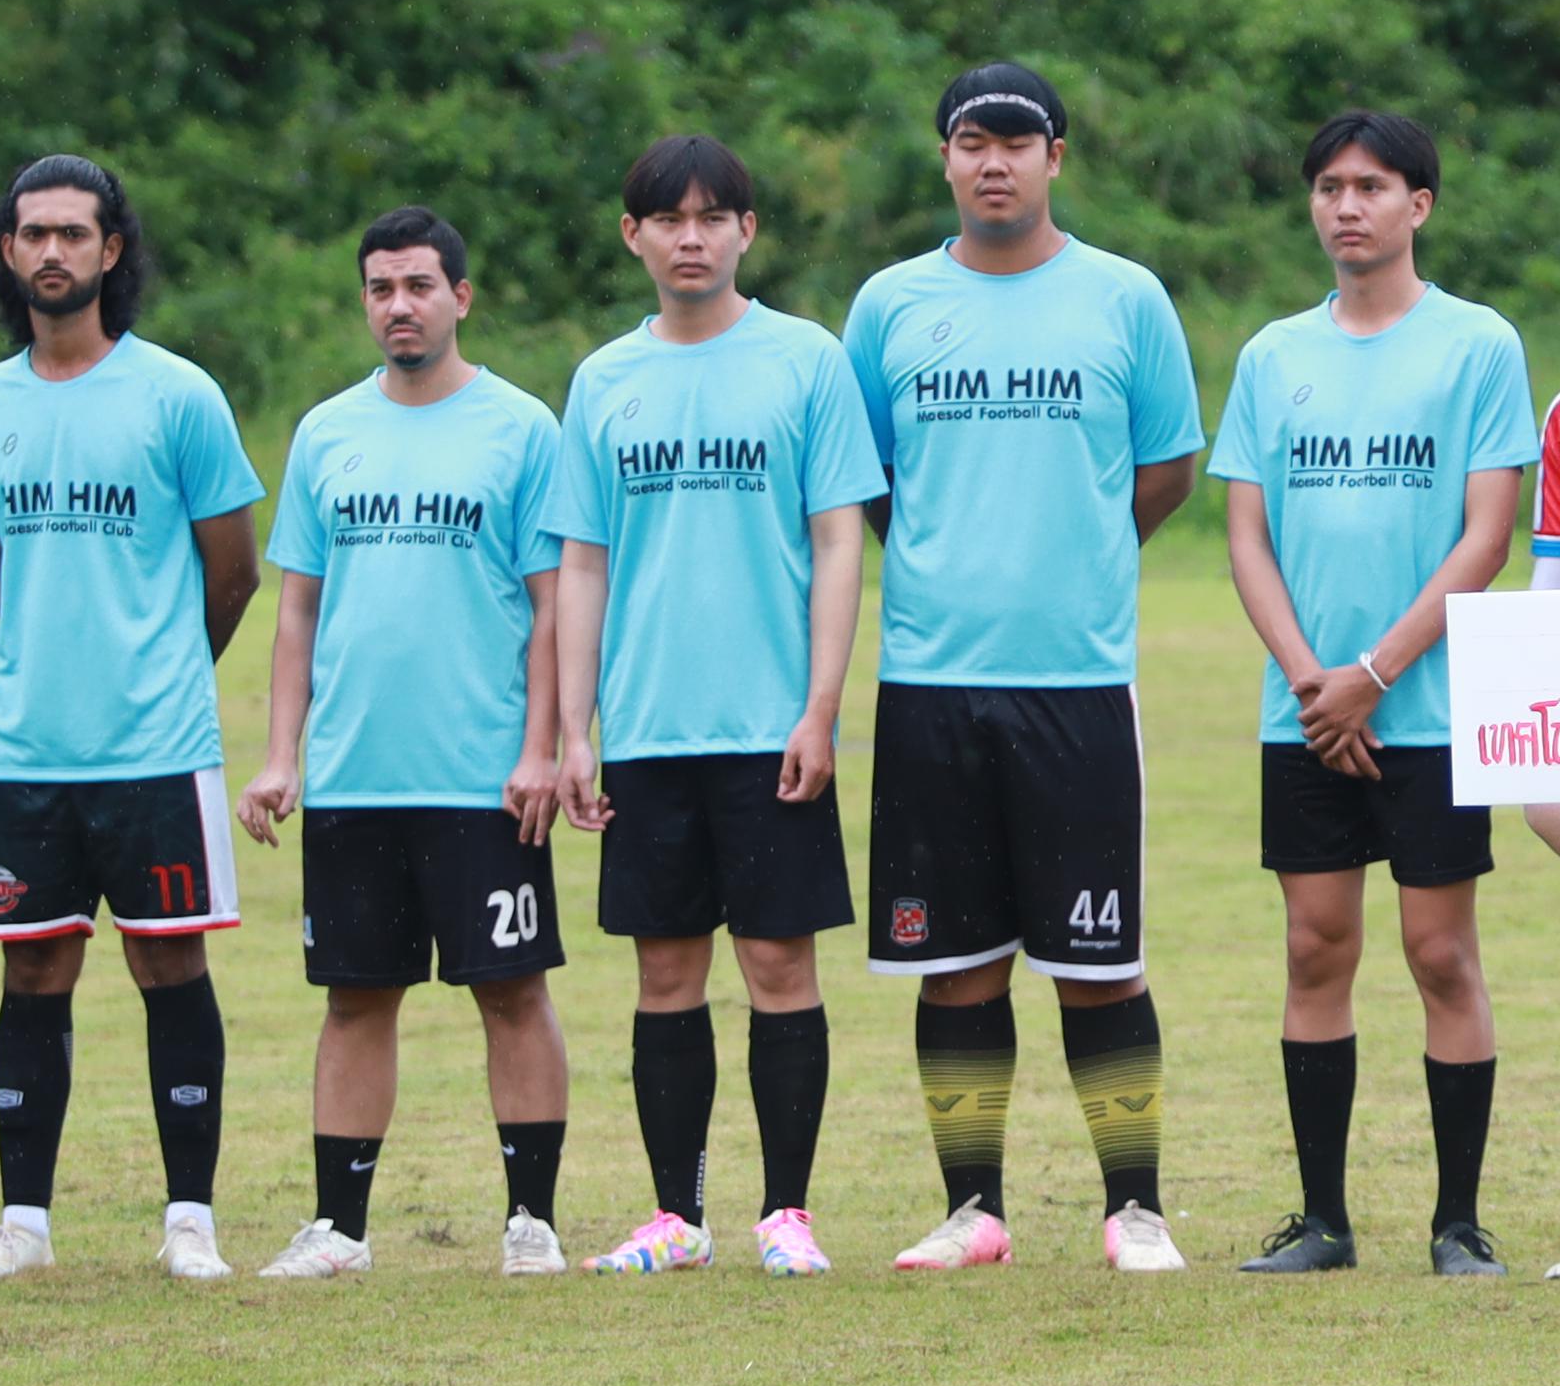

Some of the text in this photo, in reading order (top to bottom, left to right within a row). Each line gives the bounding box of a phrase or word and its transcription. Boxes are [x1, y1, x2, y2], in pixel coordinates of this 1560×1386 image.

[916, 368, 1083, 404] HIM HIM
[916, 405, 1081, 424] Maesod Football Club
[698, 438, 766, 472] HIM
[1366, 434, 1435, 469] HIM
[735, 477, 766, 493] Club
[1339, 473, 1397, 487] Football
[1401, 473, 1433, 489] Club
[102, 522, 134, 536] Club
[414, 493, 484, 534] HIM
[387, 532, 446, 546] Football
[450, 534, 474, 550] Clu
[486, 882, 538, 950] 20
[1067, 888, 1122, 936] 44
